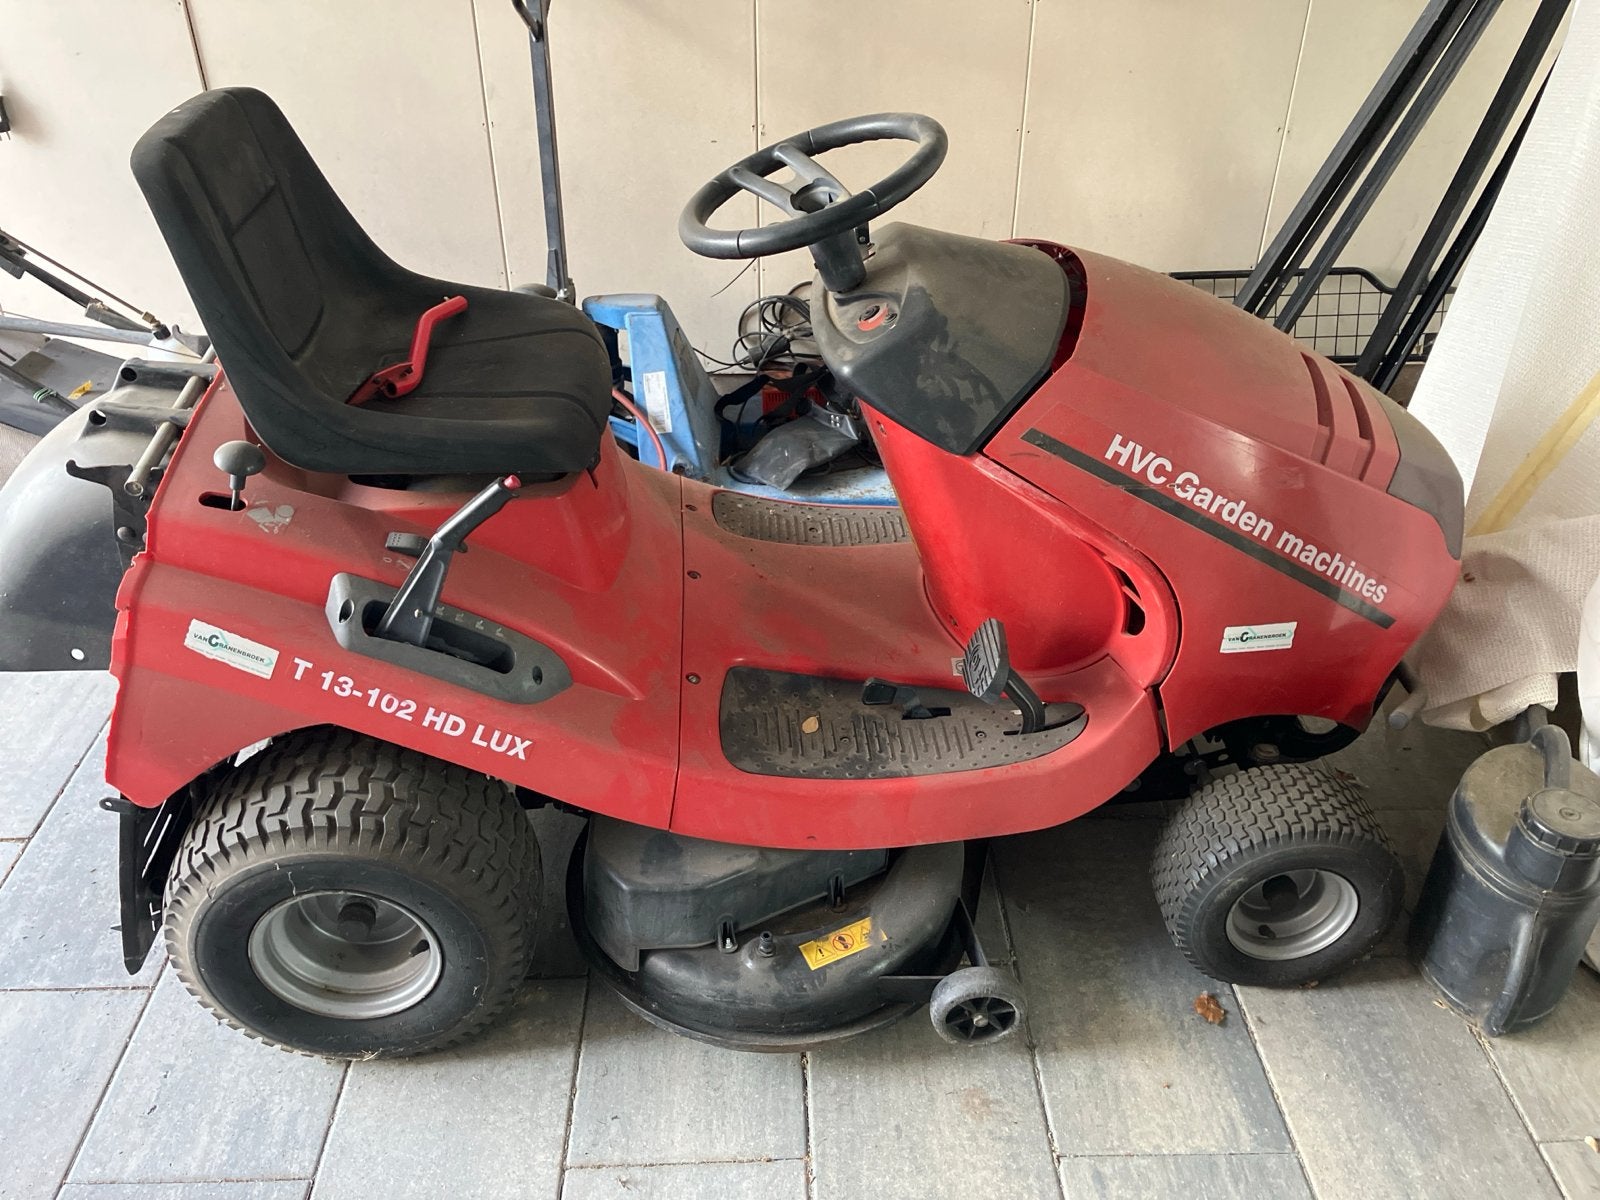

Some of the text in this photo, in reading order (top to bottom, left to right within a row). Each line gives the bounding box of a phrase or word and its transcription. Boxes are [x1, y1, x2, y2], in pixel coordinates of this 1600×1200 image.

[1105, 434, 1388, 604] HVC Garden machines
[293, 657, 314, 681] T
[320, 670, 418, 722] 13-102
[421, 707, 467, 738] HD
[471, 724, 534, 761] LUX
